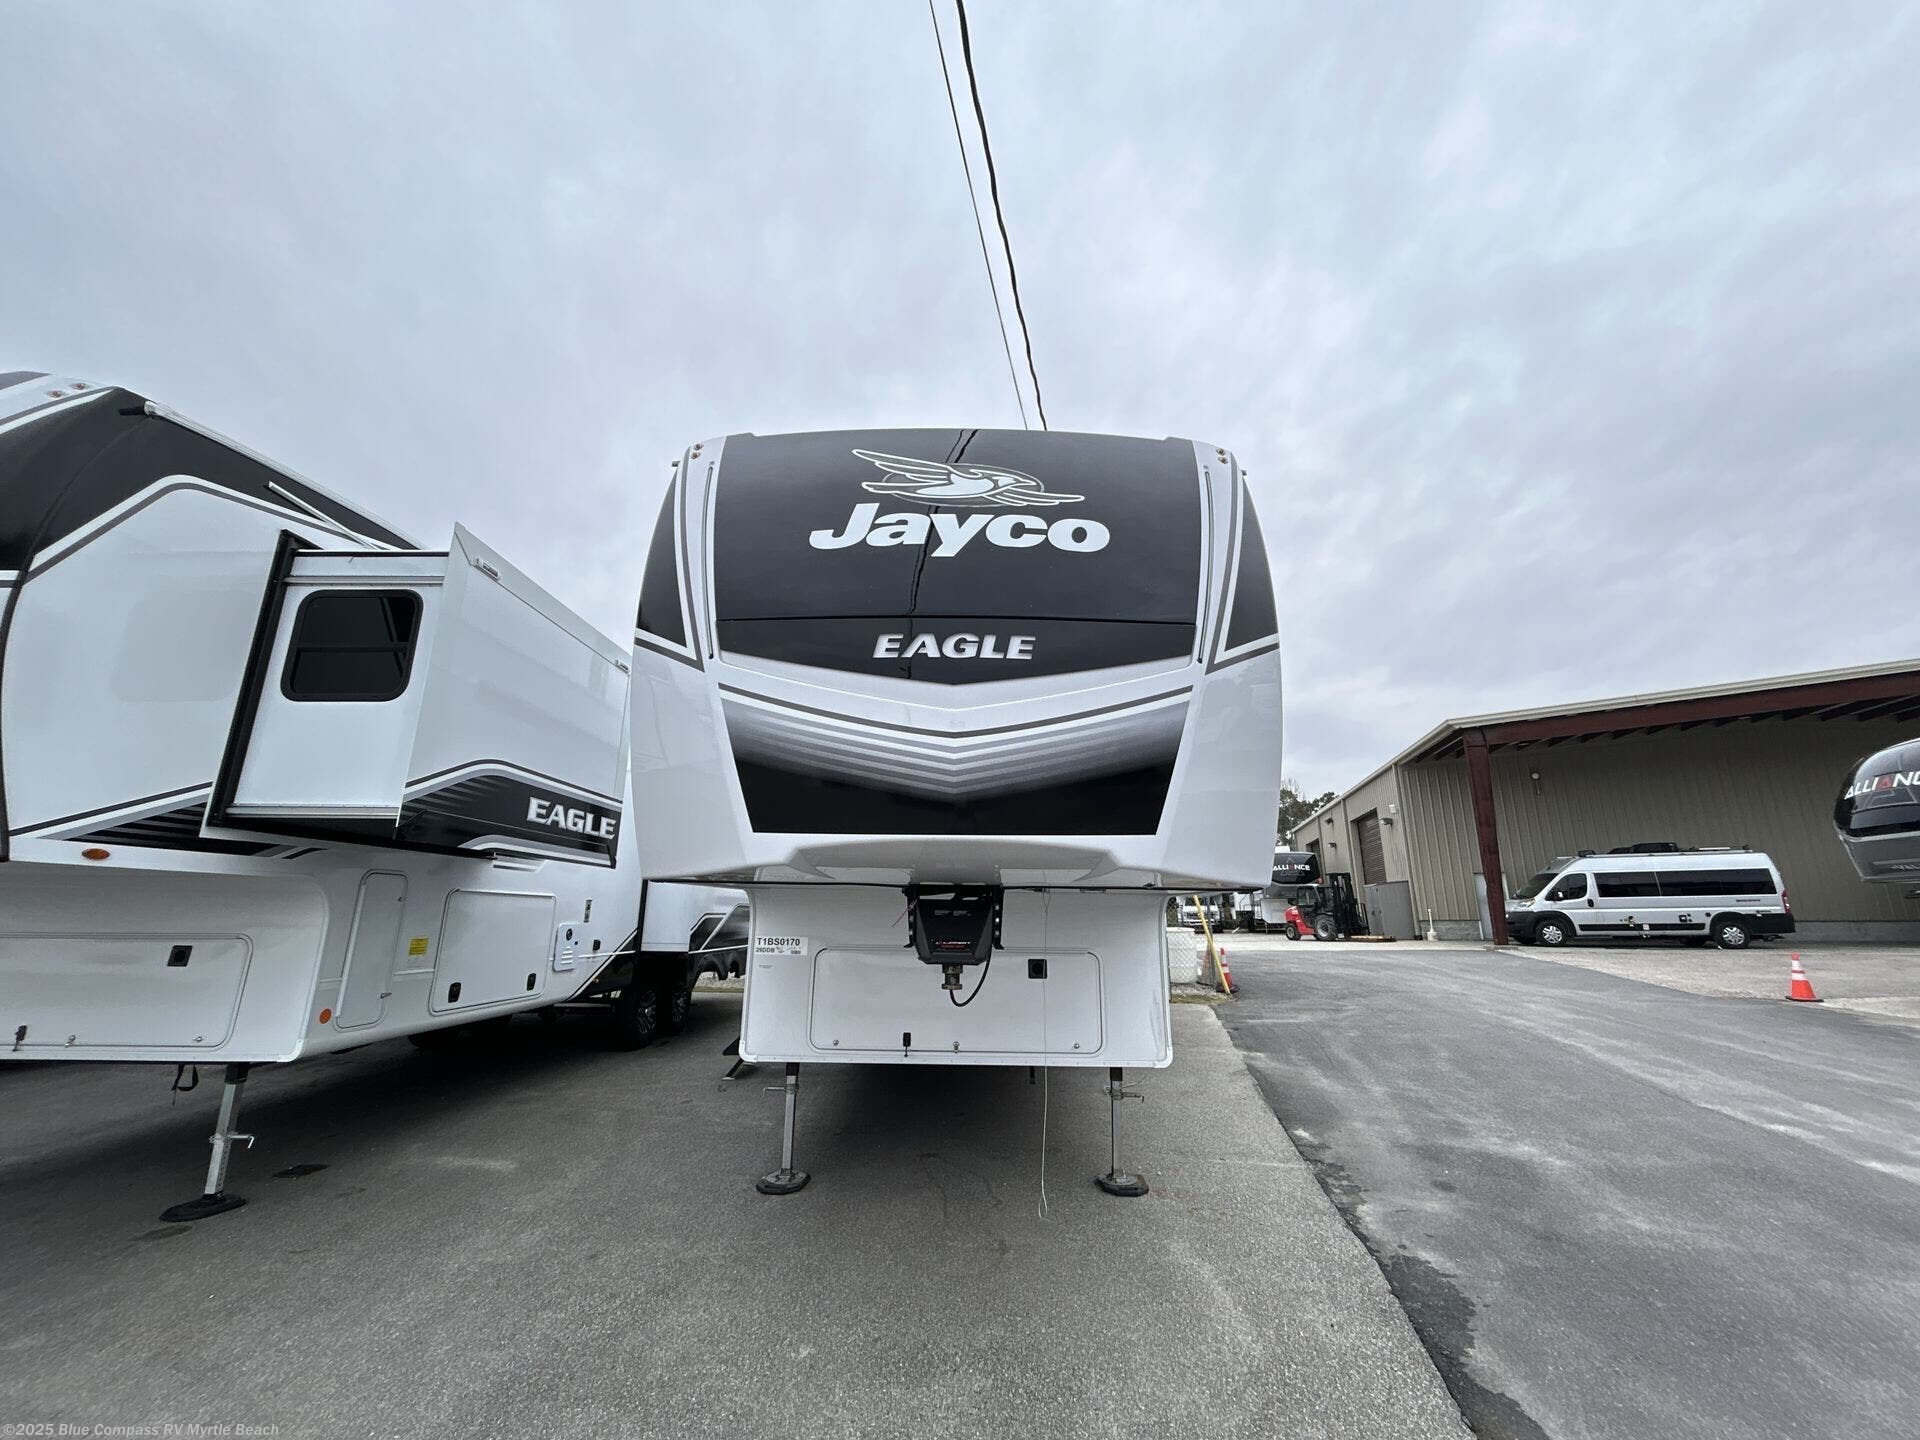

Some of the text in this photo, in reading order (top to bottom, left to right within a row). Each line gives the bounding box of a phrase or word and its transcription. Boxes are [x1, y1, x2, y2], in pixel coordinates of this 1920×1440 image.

[809, 503, 1110, 557] Jayco
[873, 632, 1037, 660] EAGLE
[526, 796, 617, 840] EAGLE
[757, 937, 800, 946] T1BS0170
